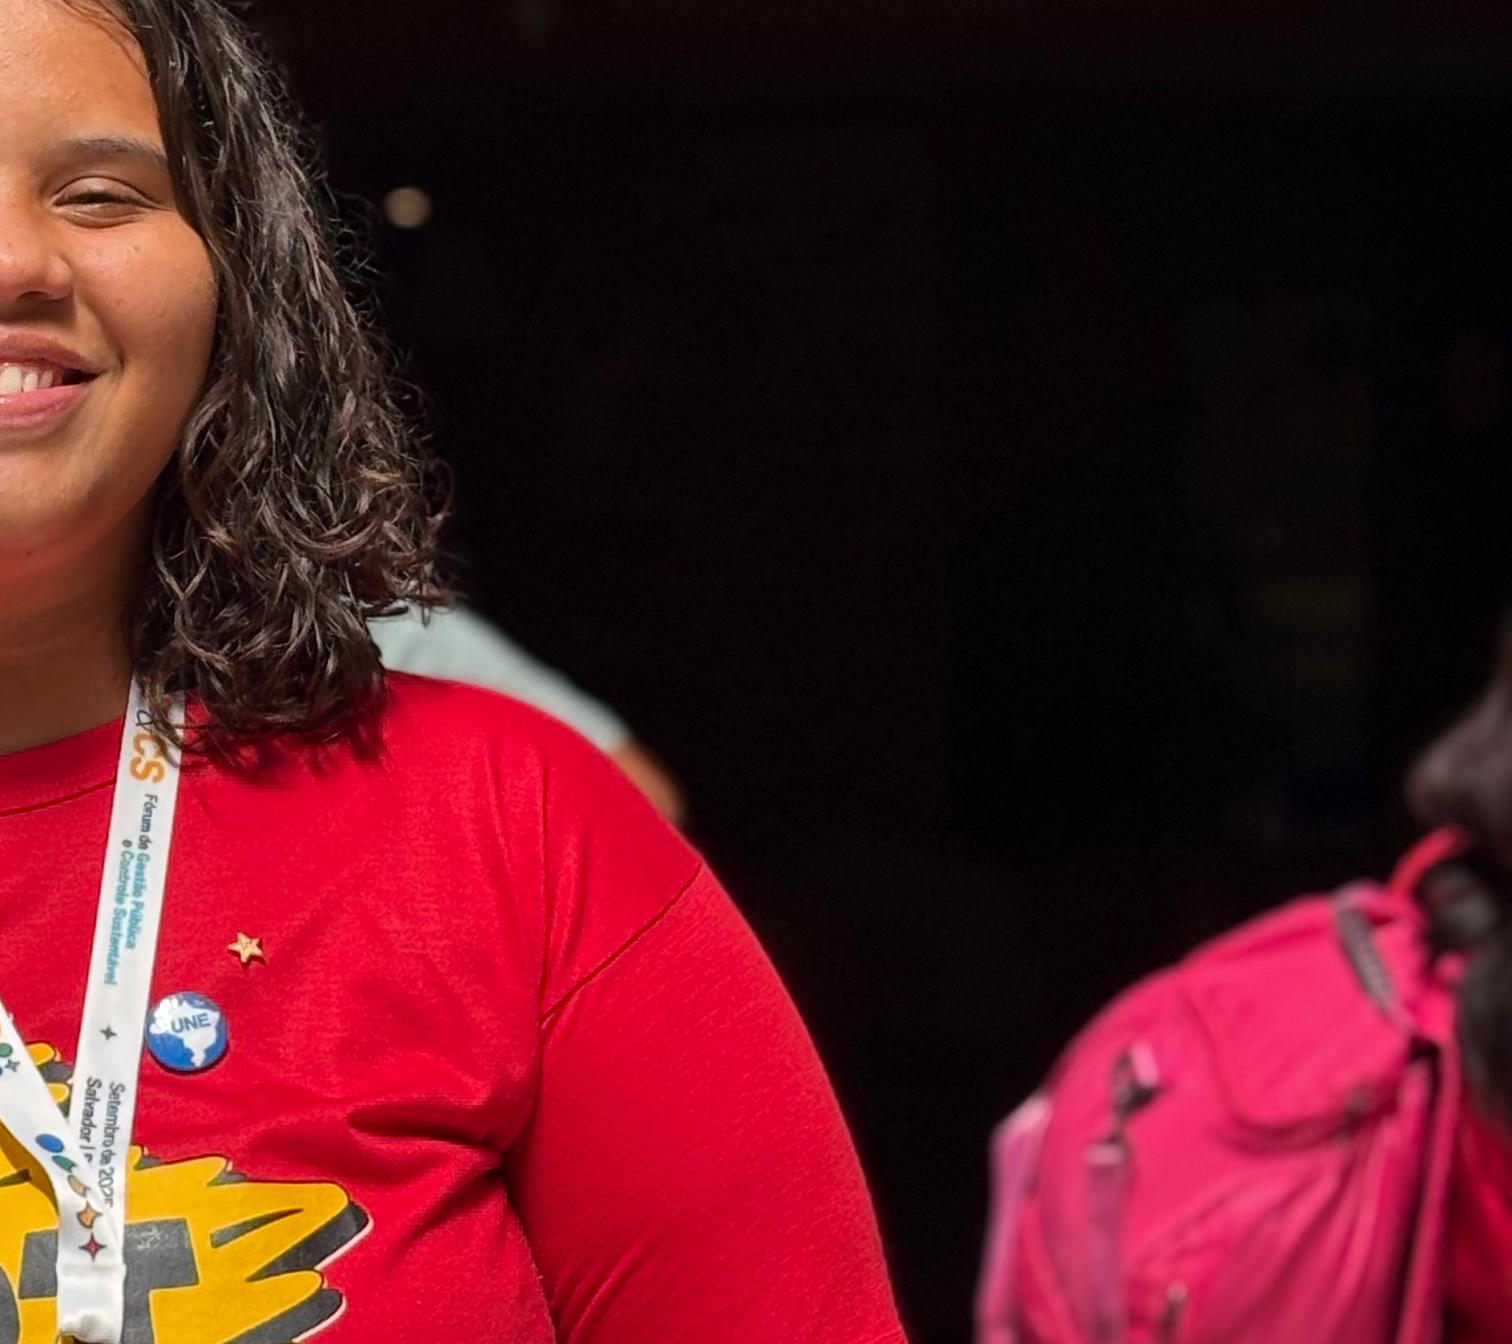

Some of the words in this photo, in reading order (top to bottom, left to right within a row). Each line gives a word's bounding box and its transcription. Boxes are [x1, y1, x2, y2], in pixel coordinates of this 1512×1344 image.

[140, 793, 158, 833] Fórum
[138, 834, 152, 850] de
[171, 1013, 211, 1033] UNE
[80, 1077, 102, 1143] Salvador
[101, 1082, 125, 1148] Setembro
[100, 1149, 116, 1165] de
